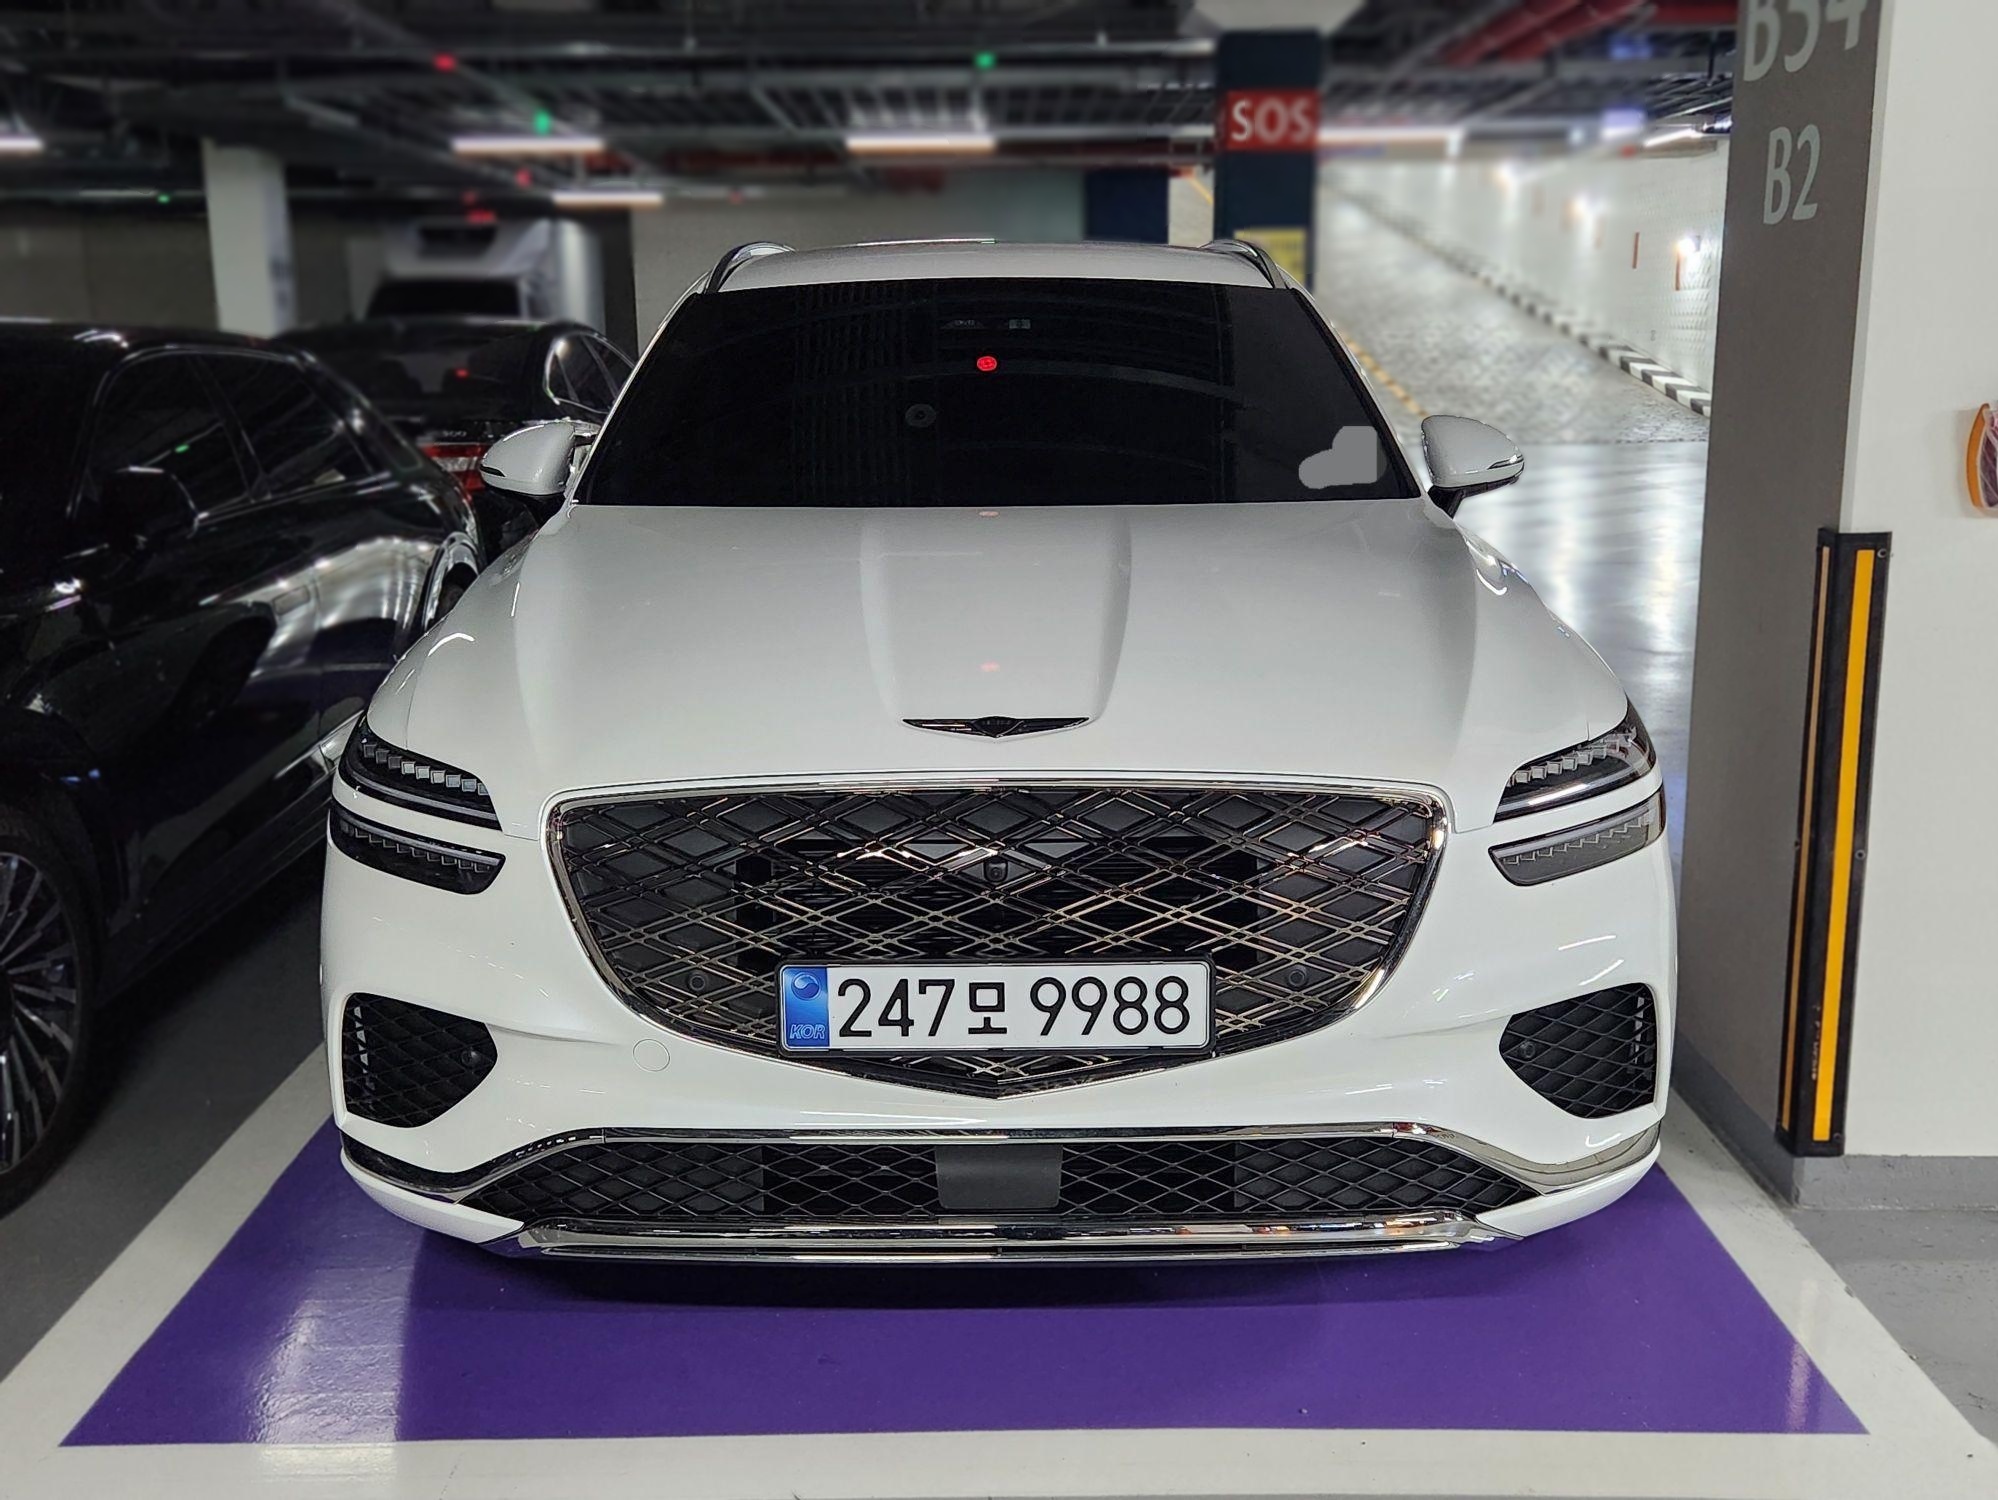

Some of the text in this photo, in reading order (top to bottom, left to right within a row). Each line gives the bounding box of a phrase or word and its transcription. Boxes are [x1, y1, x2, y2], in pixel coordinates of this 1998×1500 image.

[1743, 0, 1868, 81] B54
[1231, 97, 1312, 143] SOS
[1763, 124, 1821, 225] B2
[789, 1023, 826, 1041] KOR
[837, 976, 1190, 1038] 247모 9988
